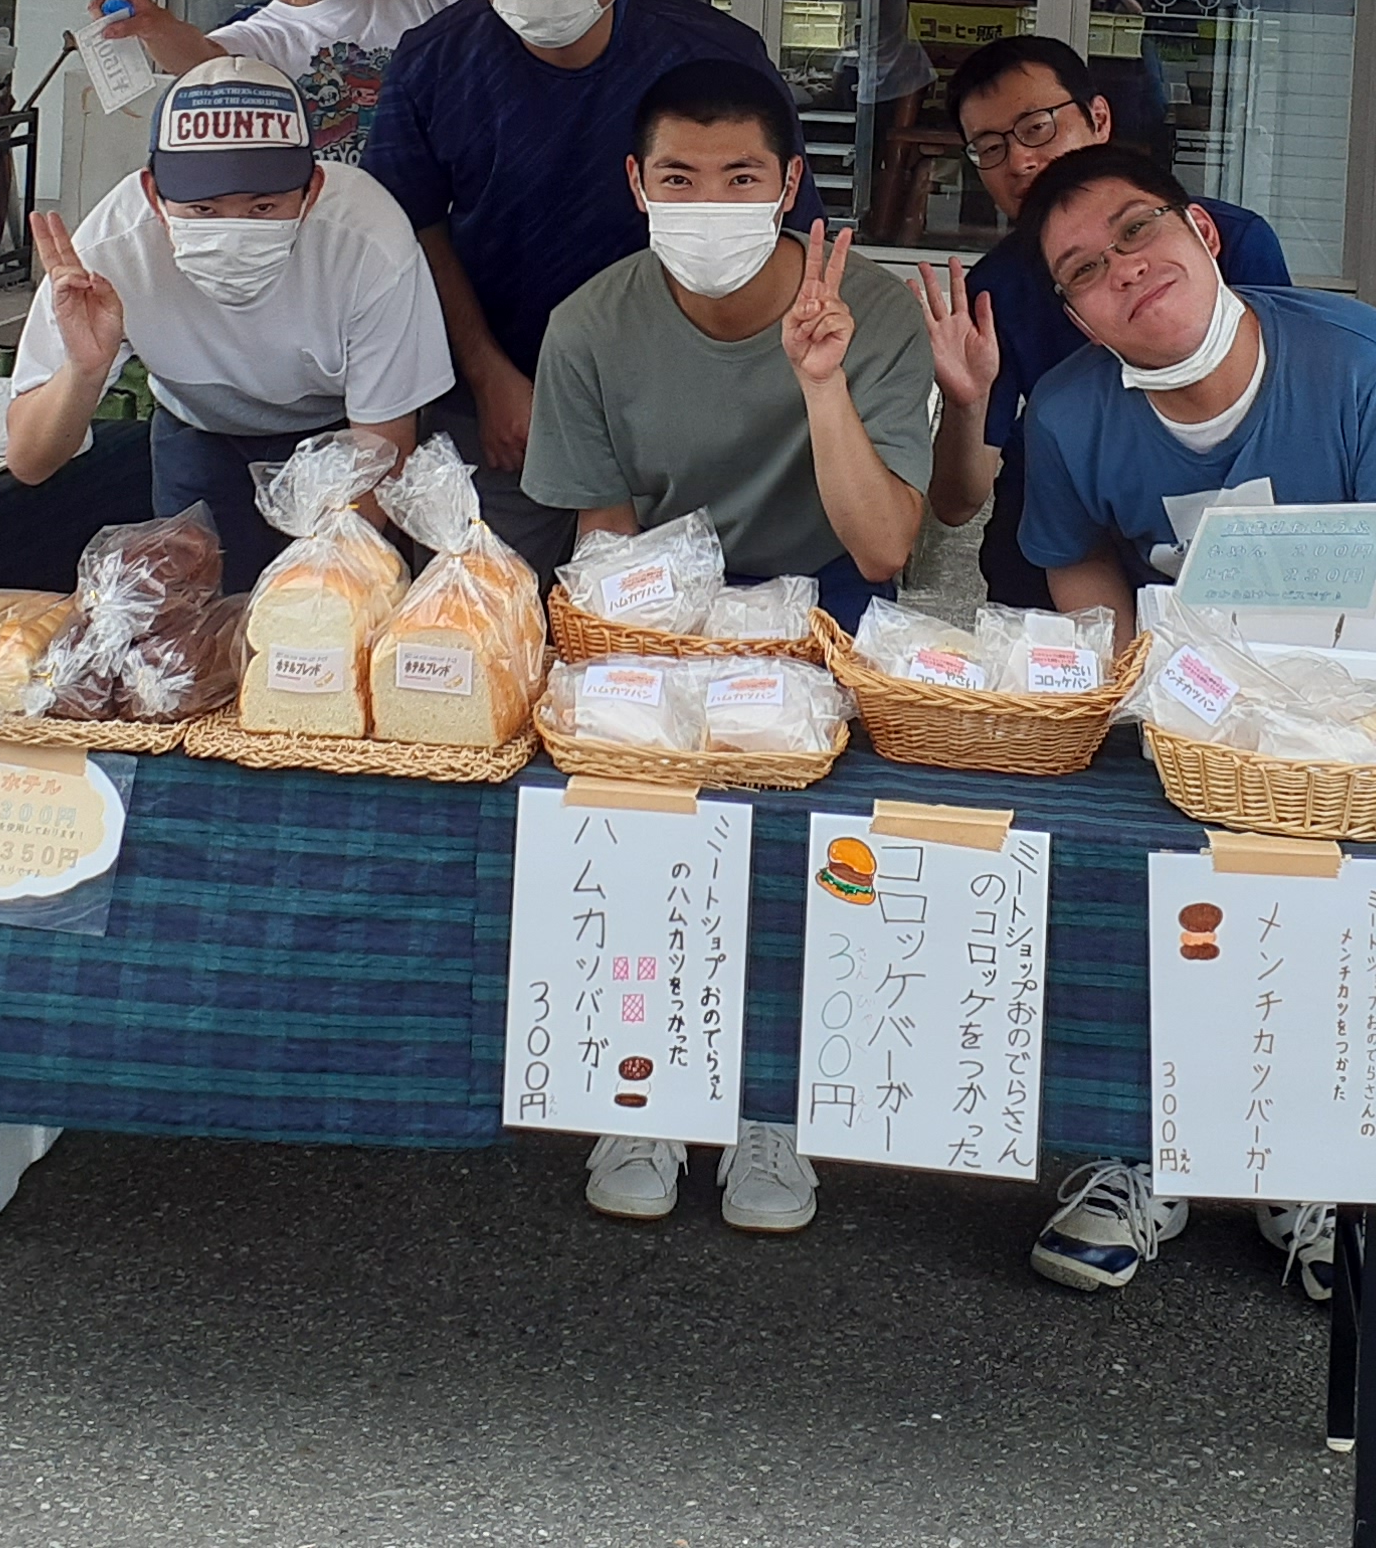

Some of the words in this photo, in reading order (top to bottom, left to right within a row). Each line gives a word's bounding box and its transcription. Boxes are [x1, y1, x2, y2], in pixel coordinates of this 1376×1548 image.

[177, 111, 292, 140] COUNTY
[610, 585, 666, 611] ハムカツパン
[586, 684, 653, 700] ハムカツパン
[711, 690, 777, 703] ハムカツパン
[1035, 674, 1092, 690] コロッケパン
[1061, 665, 1092, 677] やさい
[1165, 668, 1217, 712] メンチカツパン
[0, 840, 79, 869] 350円
[573, 815, 619, 1093] ハムカツバーガー
[667, 862, 691, 1067] のハムカツをつかった
[867, 845, 928, 1152] コロッケバーガー
[997, 839, 1039, 1168] ミートショップおのでらさん
[1333, 928, 1353, 1102] メンチカツをつかった
[519, 980, 550, 1120] 300円
[810, 932, 857, 1128] 300円
[948, 873, 1006, 1168] のコロッケをつかった
[1244, 901, 1284, 1194] メンチカツバーガー
[1159, 1061, 1178, 1172] 300円
